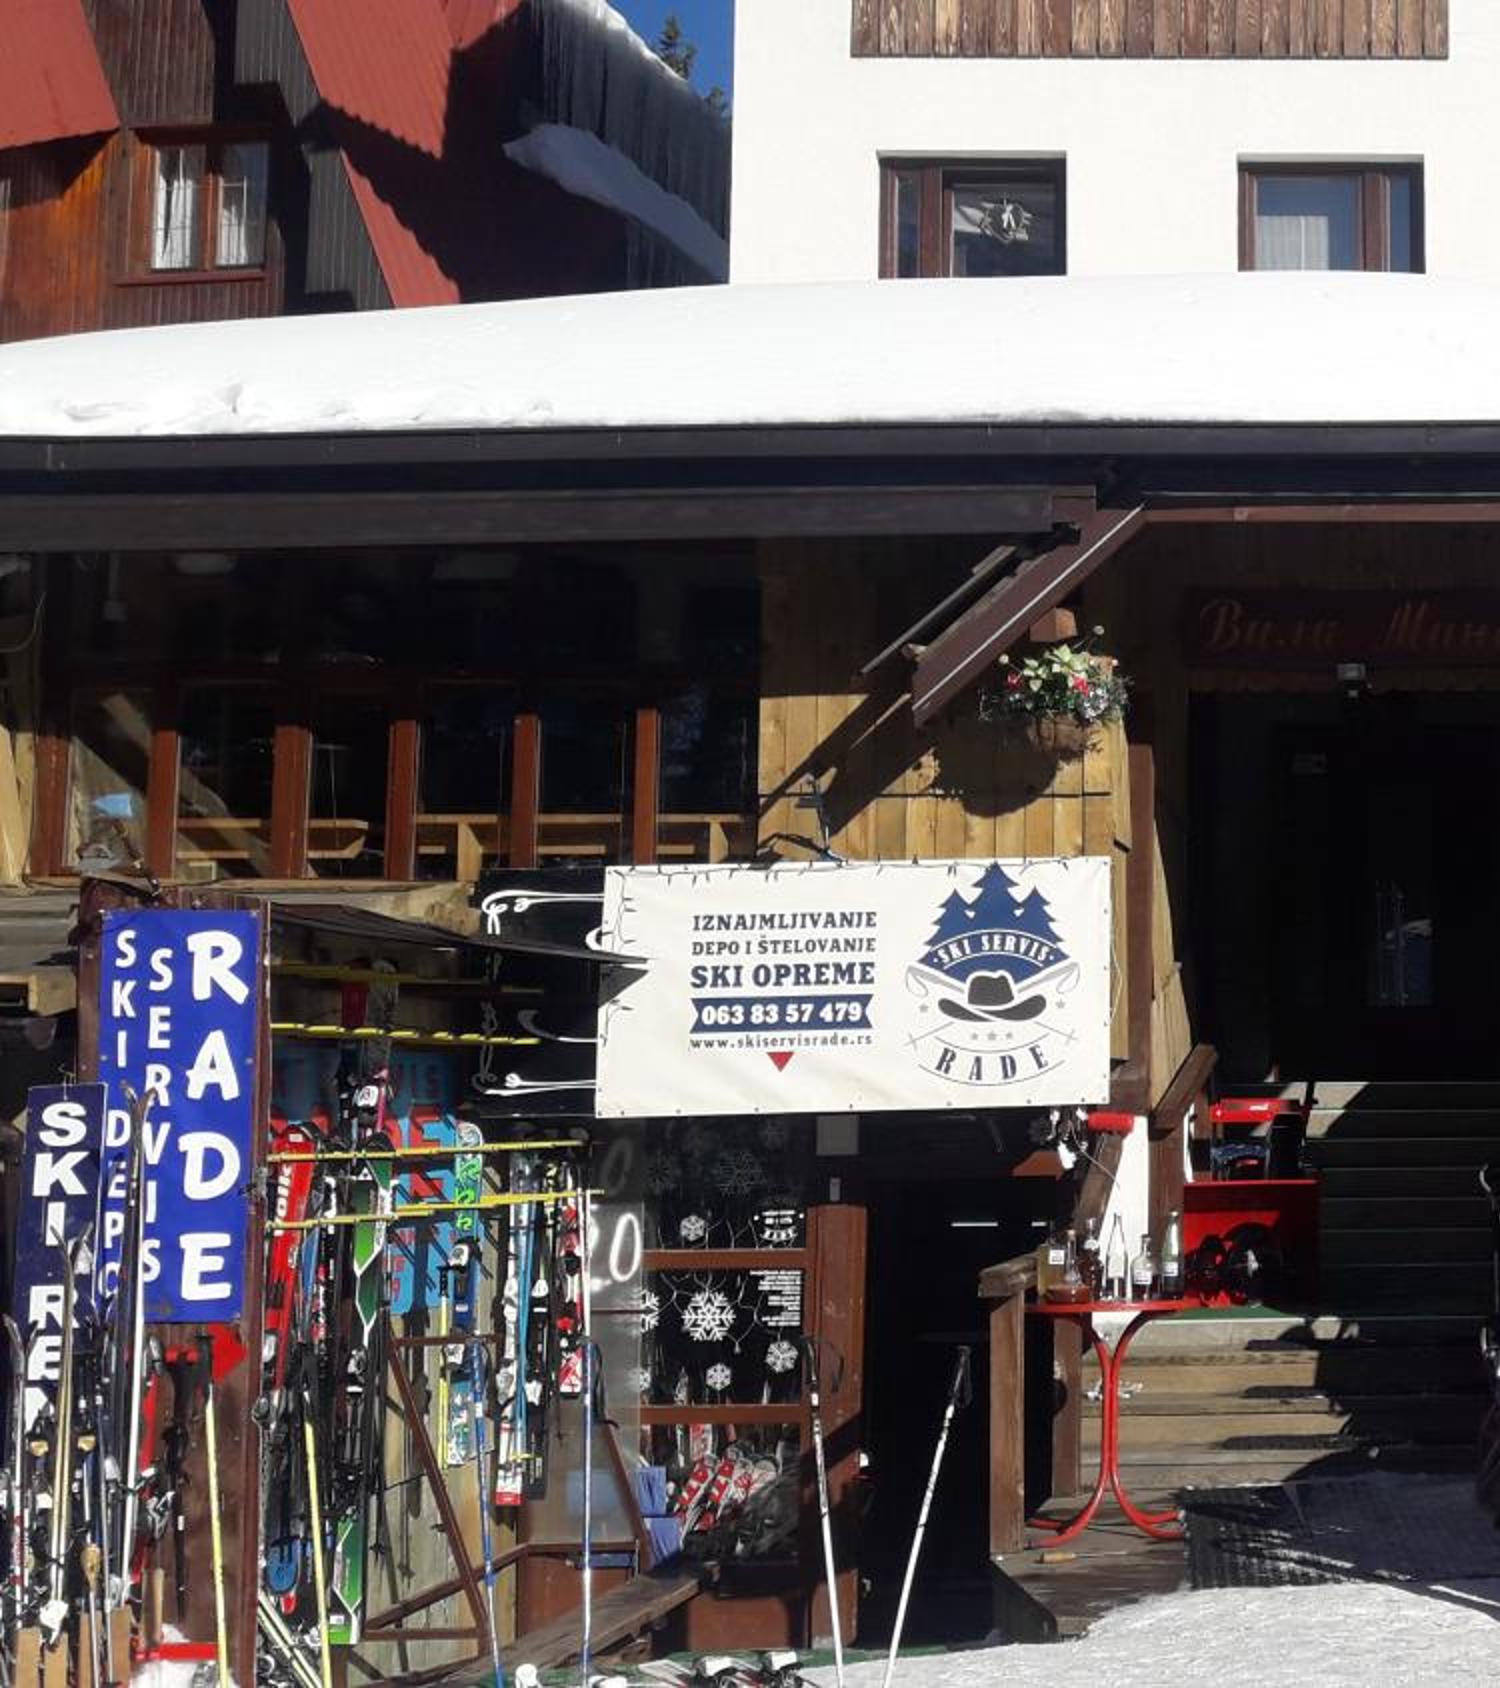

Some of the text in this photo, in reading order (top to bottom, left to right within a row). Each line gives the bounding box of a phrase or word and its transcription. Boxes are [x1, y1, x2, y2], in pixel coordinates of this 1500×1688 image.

[692, 911, 877, 931] IZNAJMLJIVANJE
[691, 934, 877, 956] DEPO I ŠTELOVANJE
[936, 933, 1050, 964] SKI SERVIS
[690, 961, 876, 988] SKI OPREME
[111, 929, 138, 1069] SKI
[701, 1001, 863, 1025] 063 83 57 479
[689, 1032, 872, 1049] www.skiservisrade.rs
[935, 1043, 1049, 1081] RADE
[142, 947, 174, 1283] SERVIS
[178, 929, 249, 1301] RADE
[33, 1101, 90, 1247] SKI
